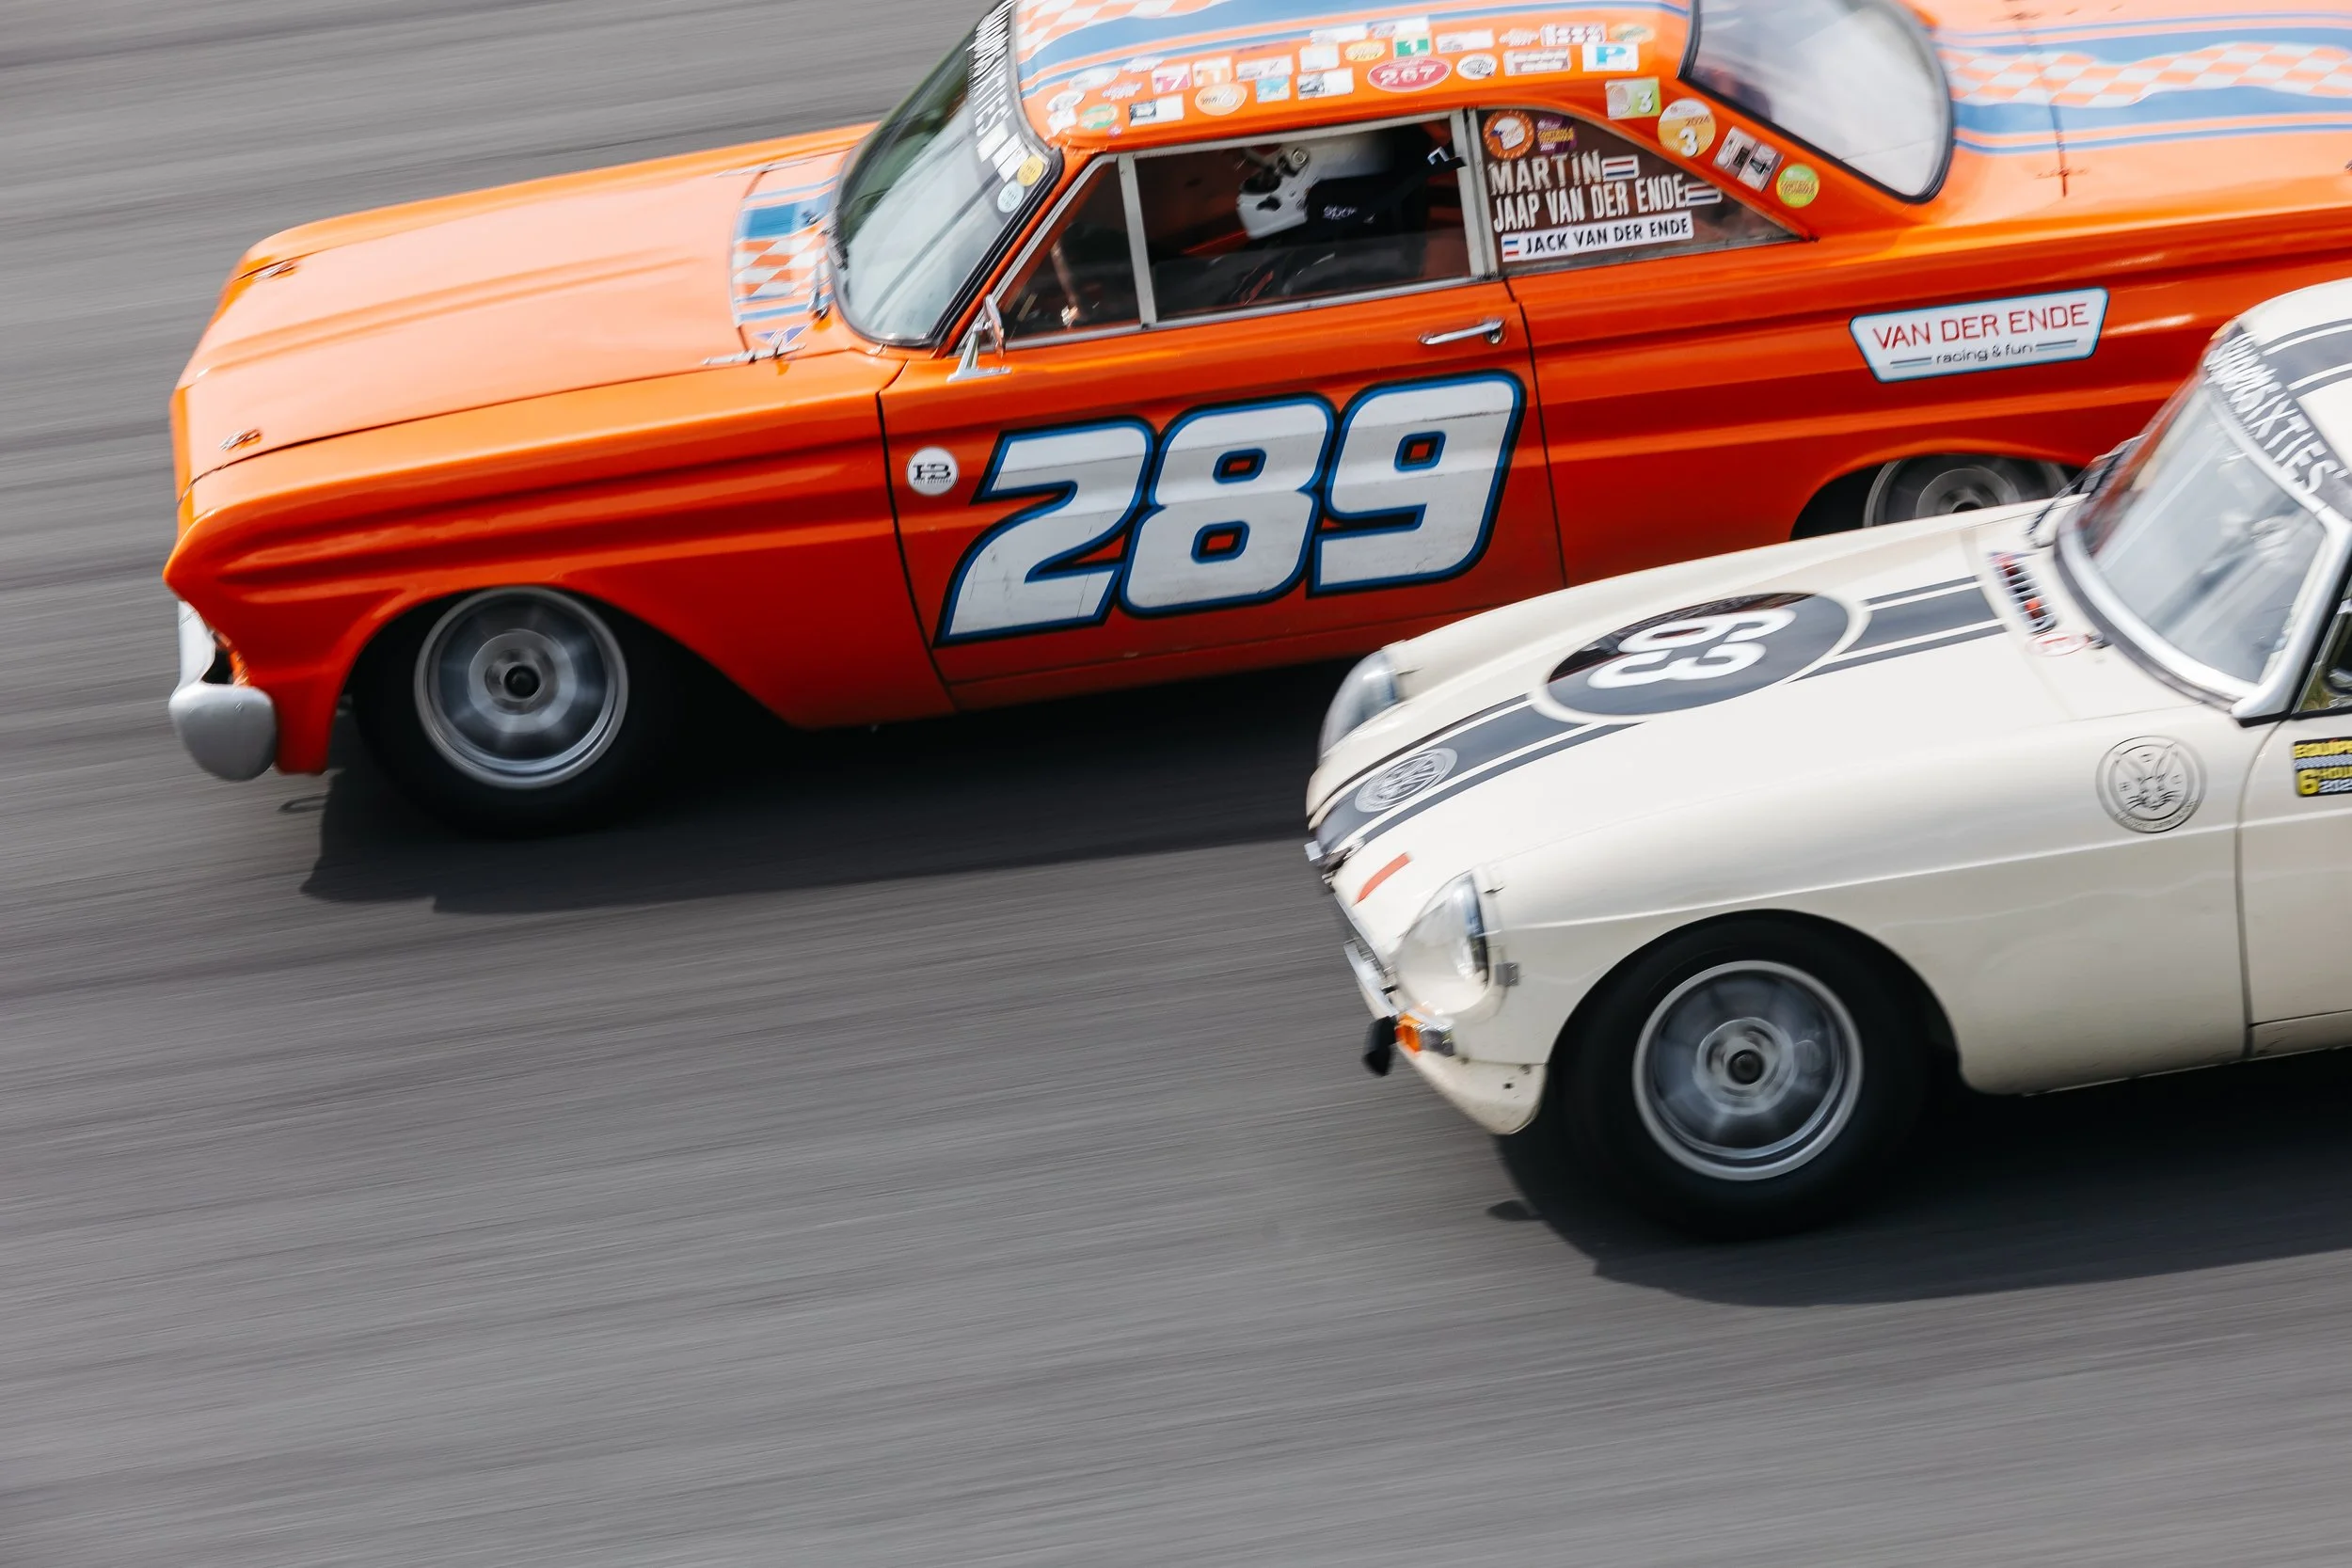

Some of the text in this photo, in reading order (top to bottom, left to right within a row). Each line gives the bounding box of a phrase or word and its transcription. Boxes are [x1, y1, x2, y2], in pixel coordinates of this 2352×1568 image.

[1637, 89, 1654, 114] 3
[1678, 126, 1699, 158] 3
[1487, 150, 1605, 196] MARTIN
[1493, 173, 1687, 233] JAAP VAN DER ENDE
[1525, 217, 1690, 255] JACK VAN DER ENDE
[1872, 303, 2090, 351] VAN DER ENDE
[1935, 341, 2034, 364] racing & fun
[939, 373, 1522, 644] 289
[2297, 768, 2319, 795] 6
